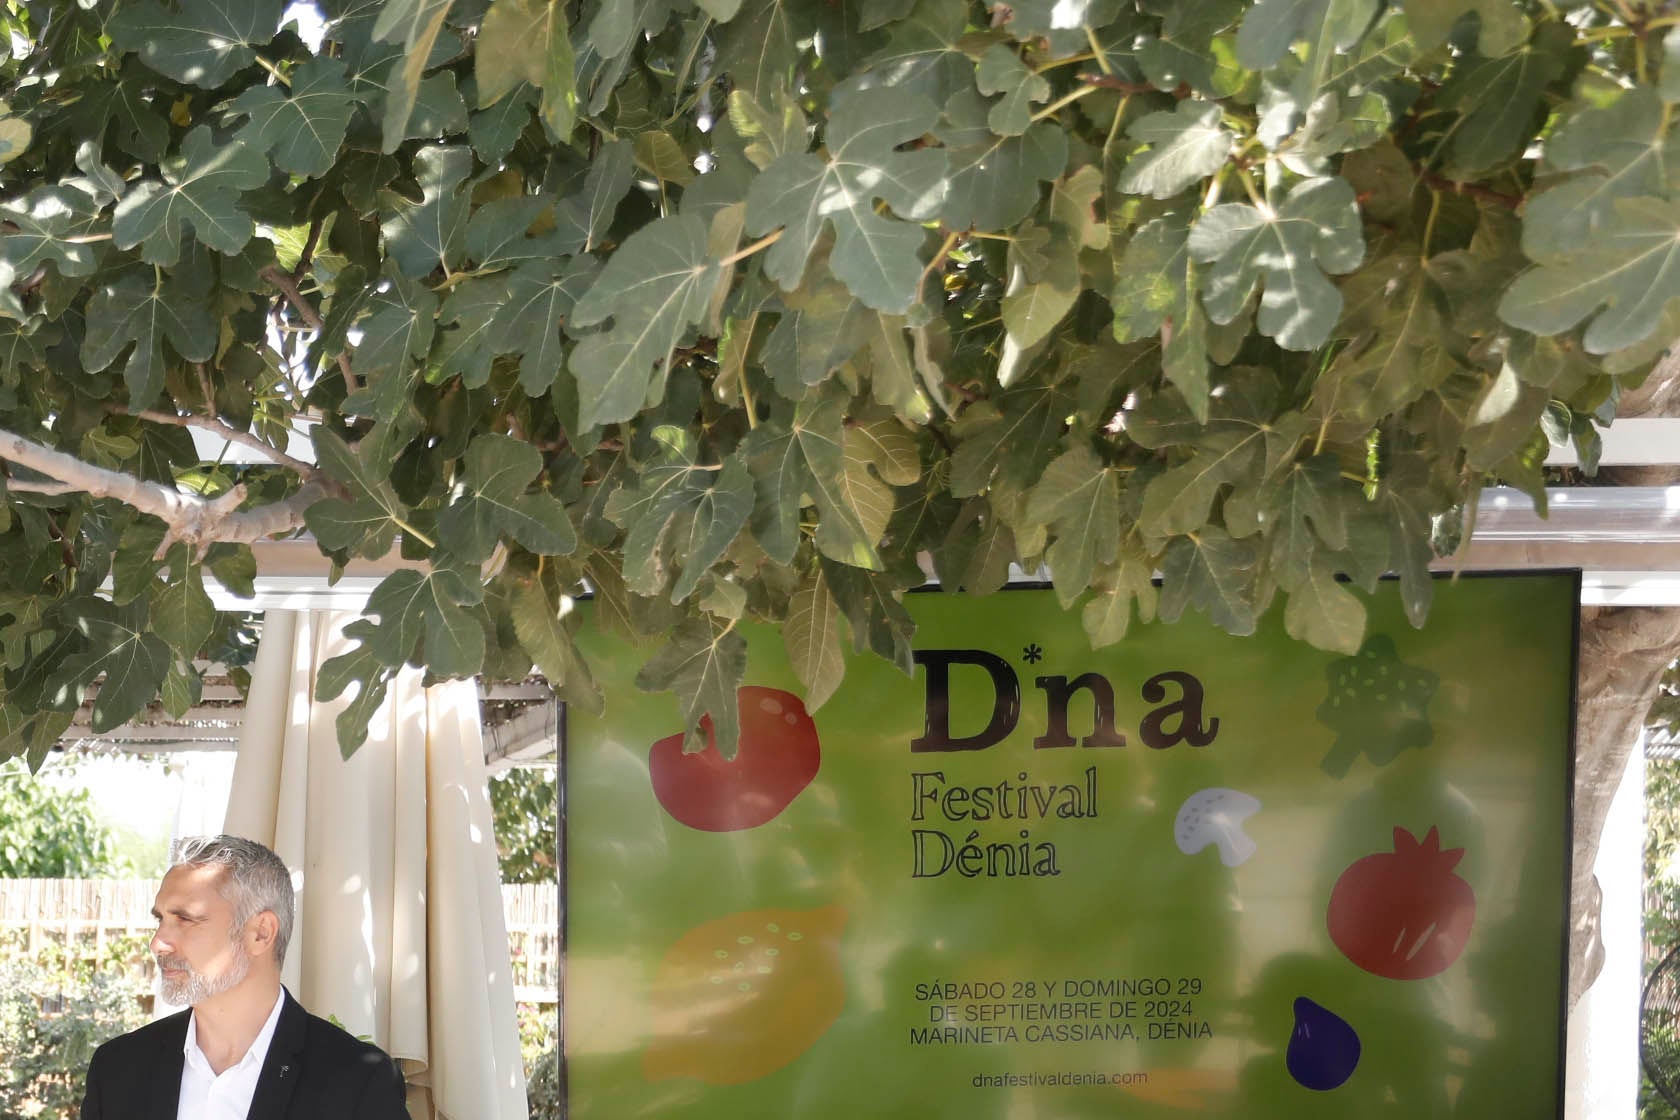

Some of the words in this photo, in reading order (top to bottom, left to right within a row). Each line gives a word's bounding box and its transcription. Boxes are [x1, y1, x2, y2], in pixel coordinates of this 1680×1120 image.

[911, 766, 1098, 821] Festival
[912, 829, 1061, 878] Dénia
[915, 979, 1005, 1001] SÁBADO
[1011, 981, 1035, 999] 28
[1044, 981, 1057, 998] Y
[1064, 978, 1171, 998] DOMINGO
[1177, 977, 1202, 995] 29
[930, 1006, 959, 1023] DE
[964, 1002, 1100, 1022] SEPTIEMBRE
[1109, 1001, 1137, 1019] DE
[1143, 1000, 1193, 1018] 2024
[910, 1025, 1019, 1045] MARINETA
[1025, 1022, 1140, 1043] CASSIANA,
[1148, 1019, 1213, 1040] DÉNIA
[972, 1071, 1148, 1088] dnafestivaldenia.com
